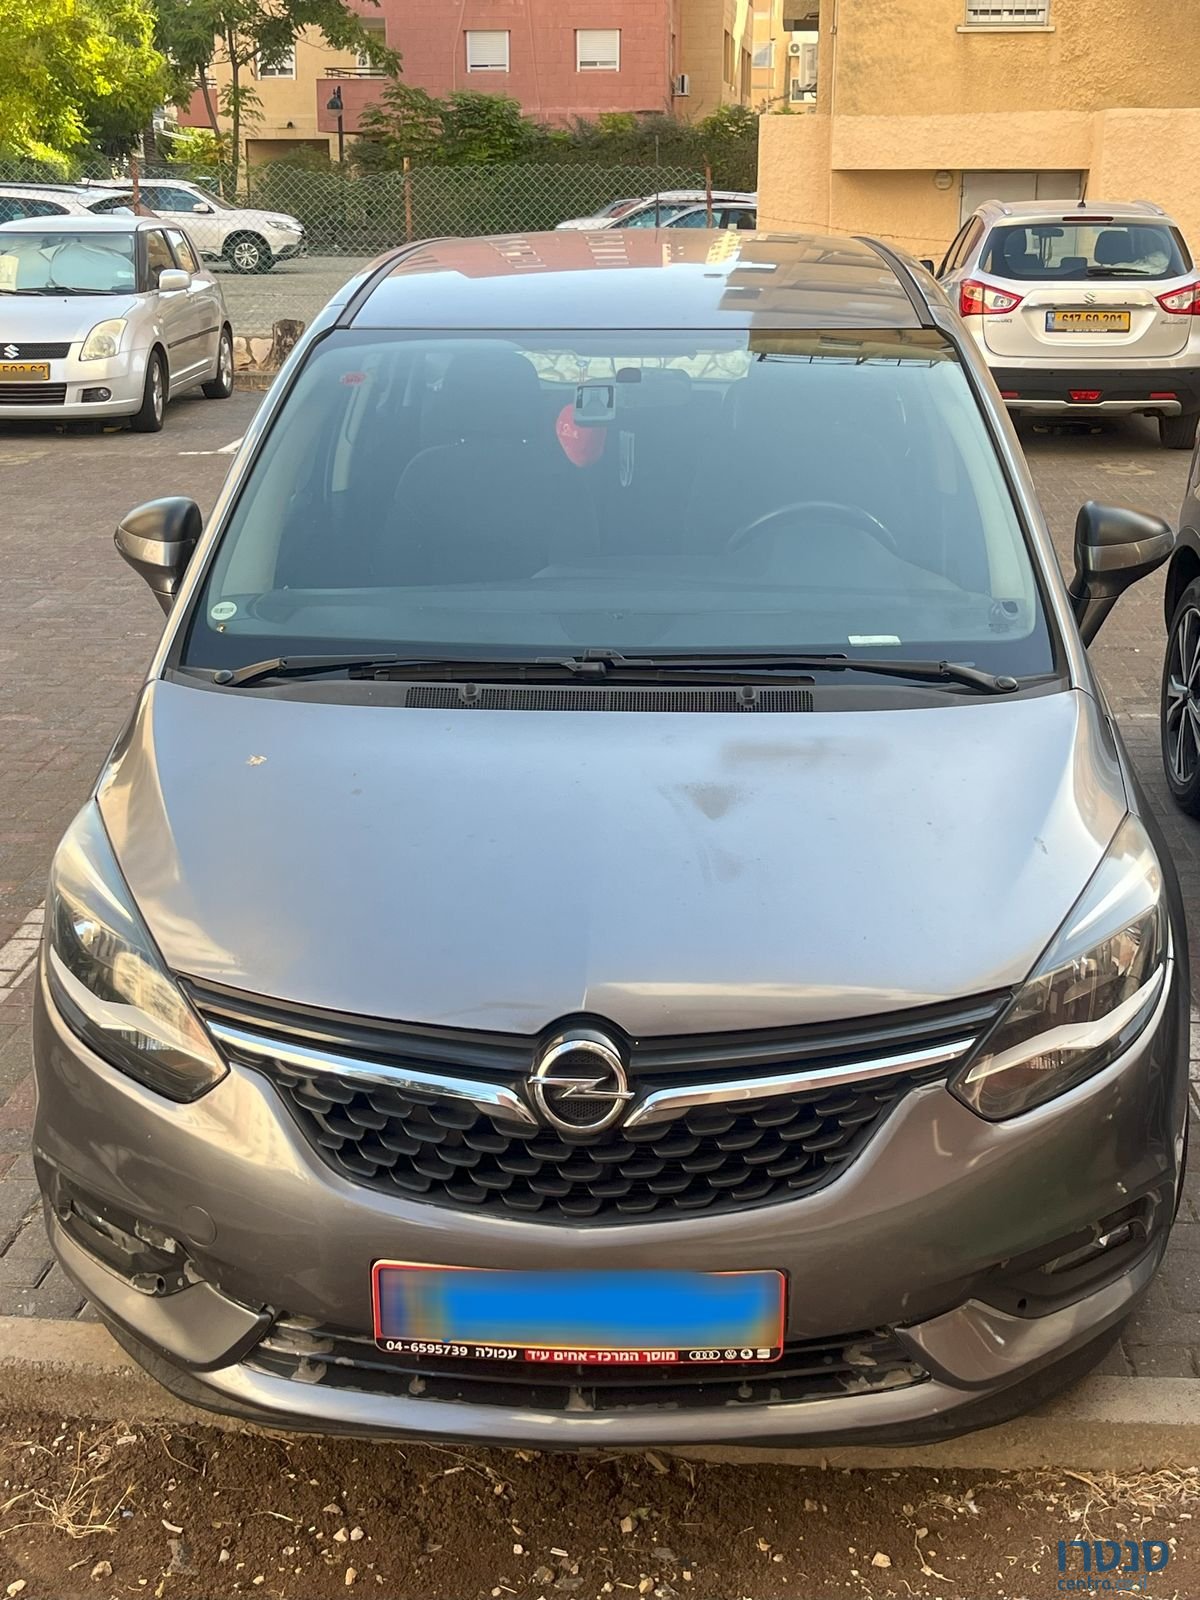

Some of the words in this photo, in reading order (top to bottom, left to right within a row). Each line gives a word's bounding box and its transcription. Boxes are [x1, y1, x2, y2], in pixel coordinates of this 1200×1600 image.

[386, 1340, 468, 1357] 04-6595739
[475, 1347, 518, 1360] עפולה
[642, 1350, 677, 1363] מוסך
